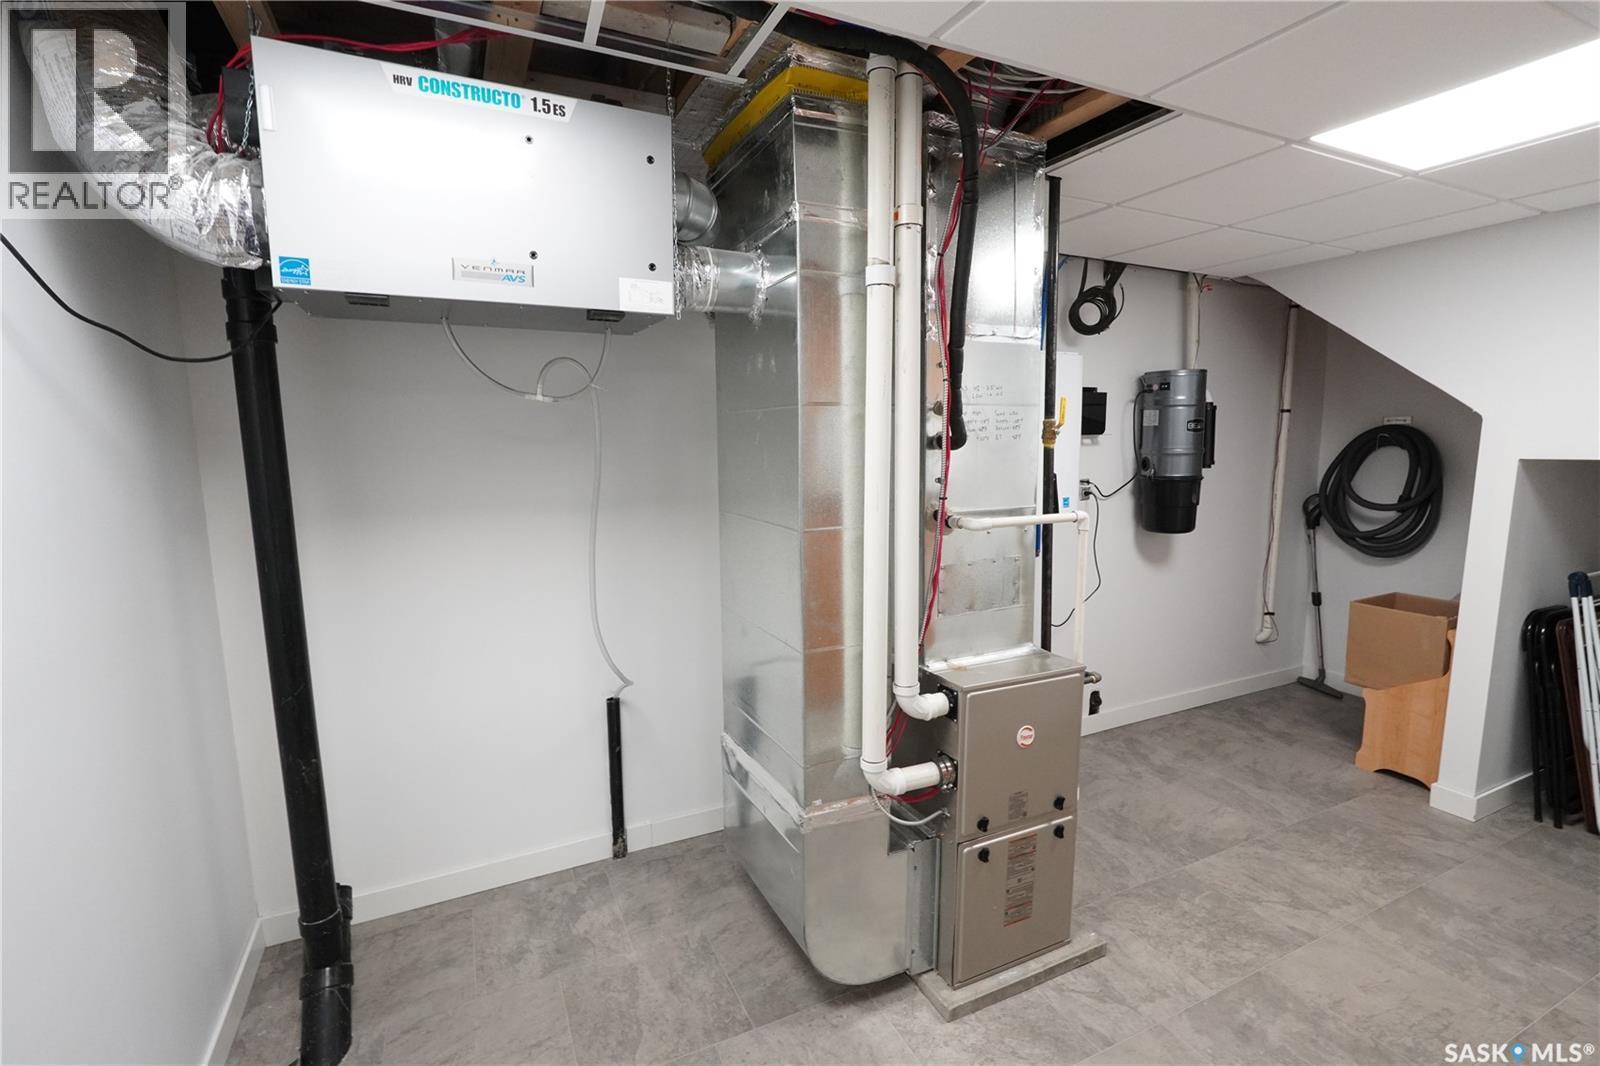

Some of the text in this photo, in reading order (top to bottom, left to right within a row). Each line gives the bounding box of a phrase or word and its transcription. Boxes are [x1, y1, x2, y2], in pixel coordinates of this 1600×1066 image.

[393, 74, 412, 87] HRV
[418, 75, 521, 109] CONSTRUCTO
[502, 274, 526, 283] AVS
